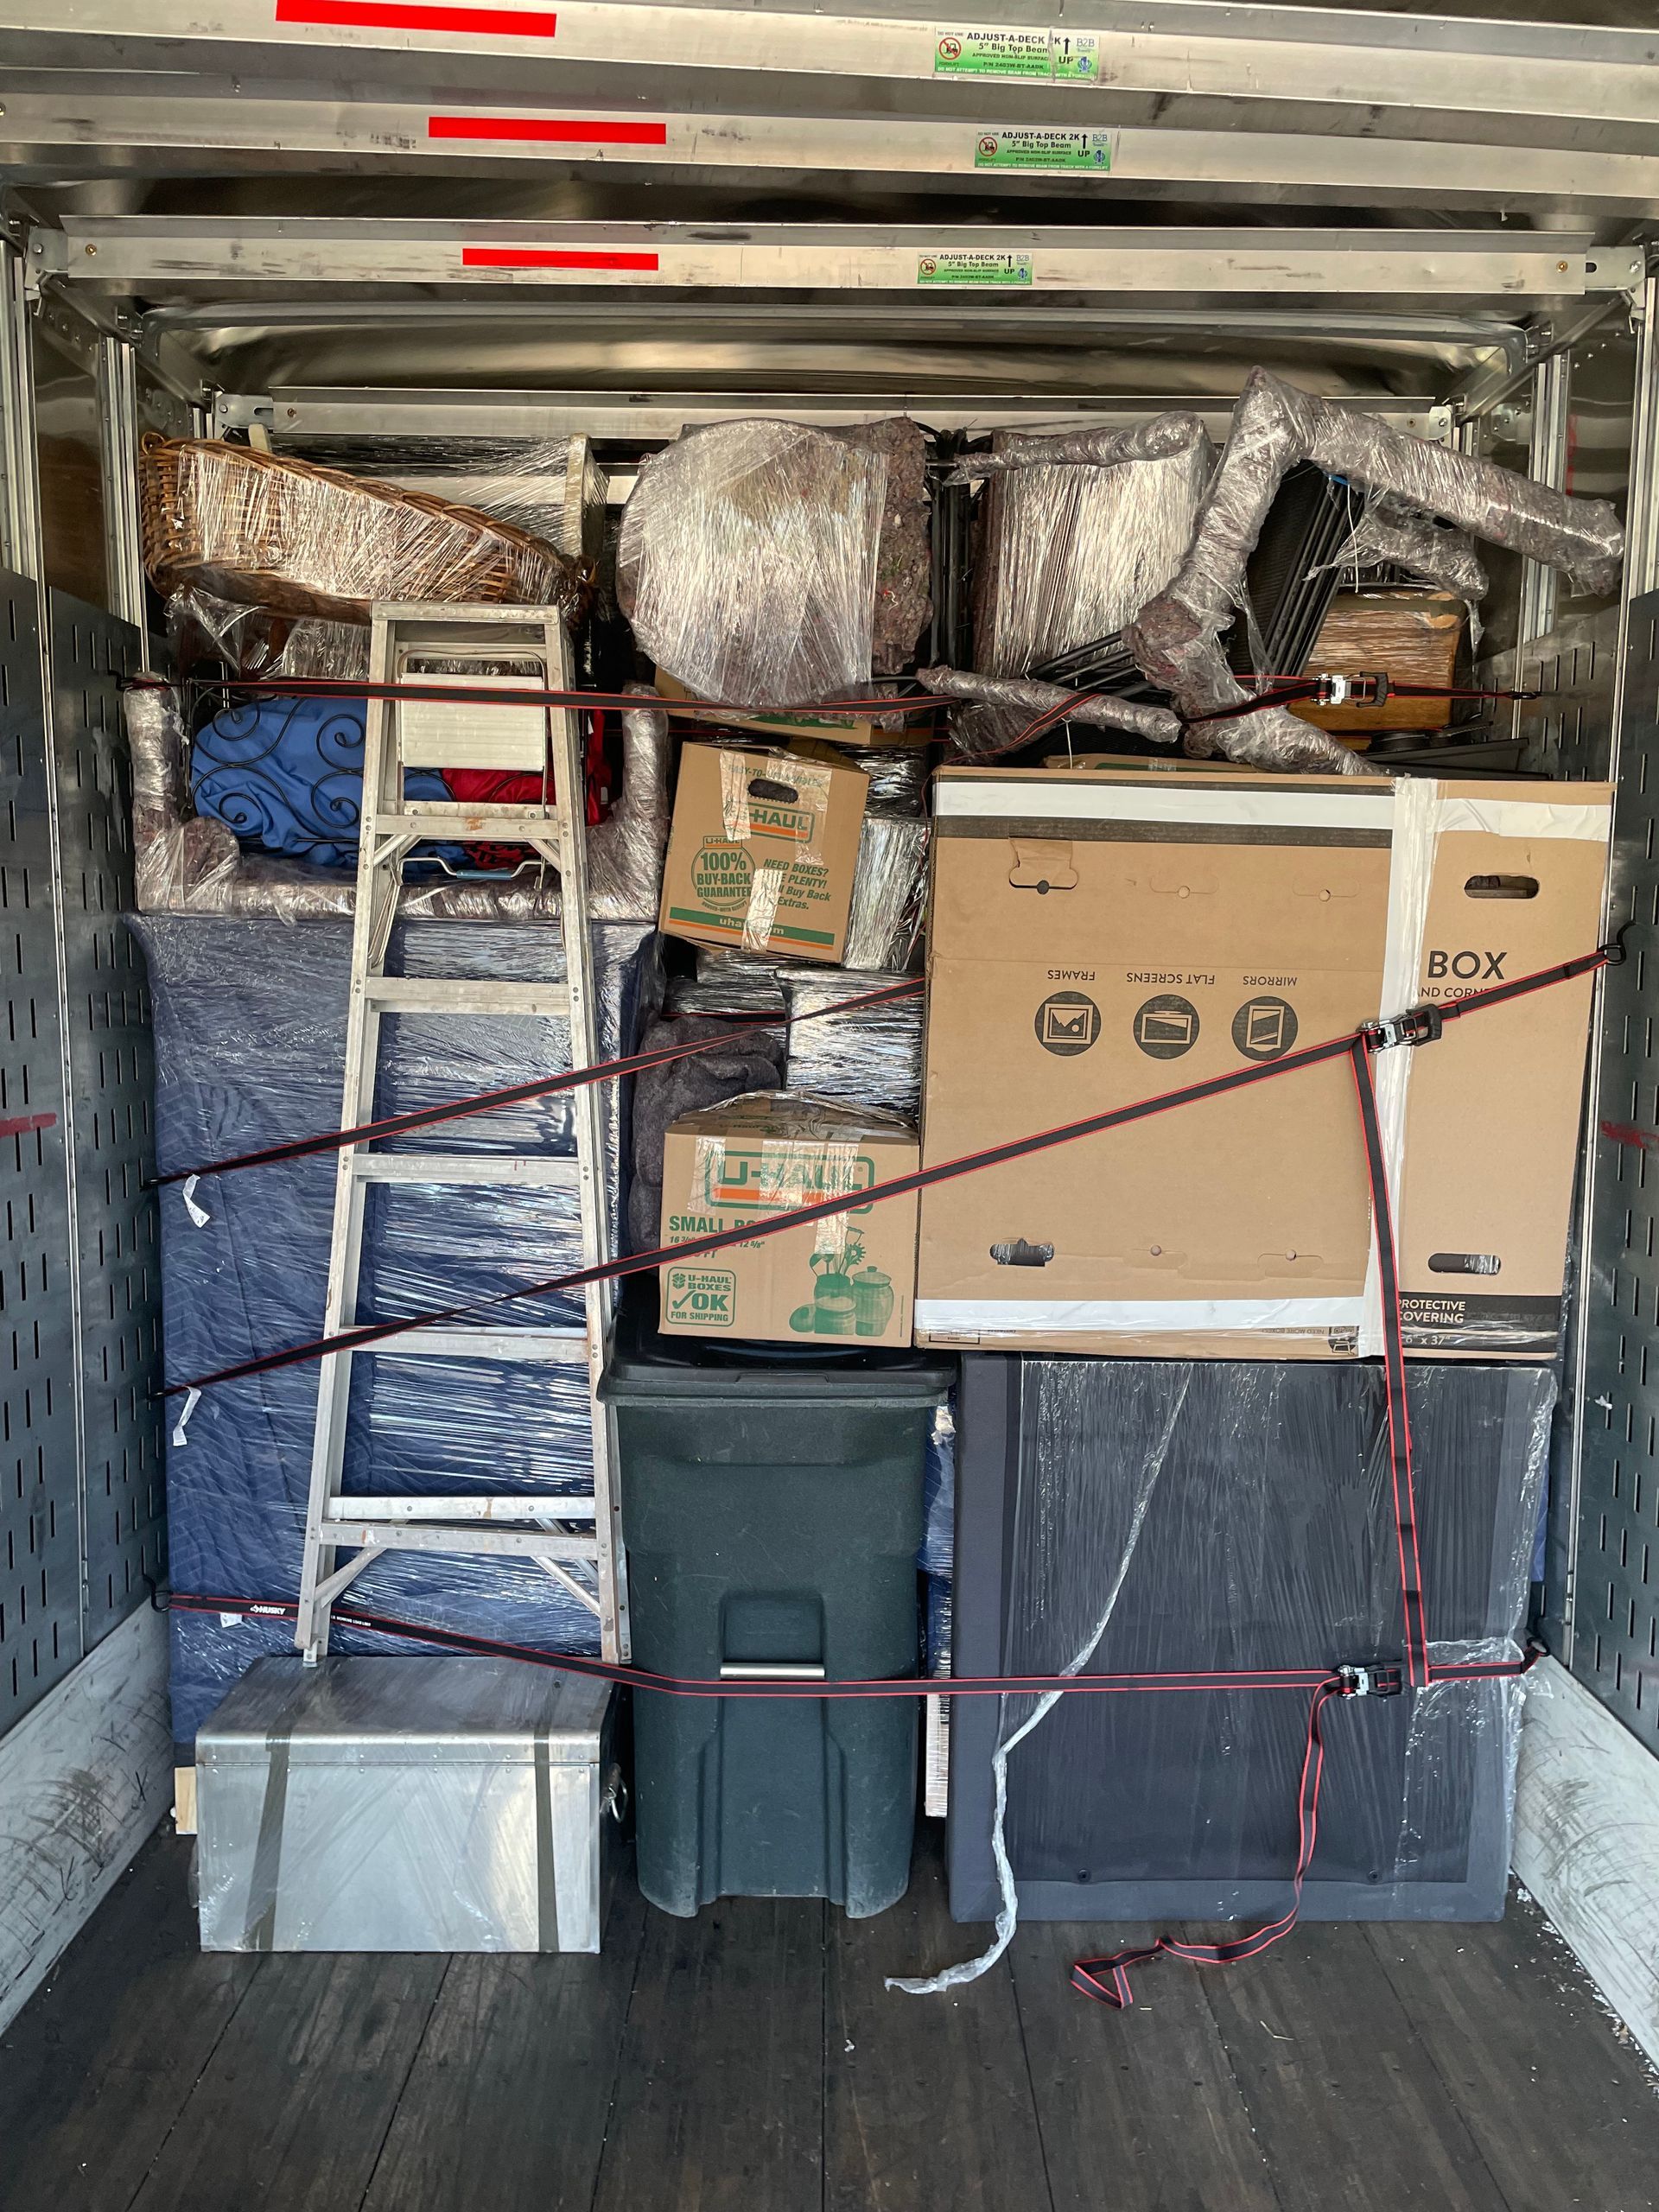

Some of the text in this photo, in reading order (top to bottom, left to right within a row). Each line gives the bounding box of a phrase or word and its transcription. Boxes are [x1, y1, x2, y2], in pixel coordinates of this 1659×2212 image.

[967, 32, 1045, 44] ADJUST-A-DECK
[1077, 38, 1095, 47] B2B
[991, 43, 1006, 53] Big
[1008, 44, 1023, 54] Top
[1001, 131, 1066, 140] ADJUST-A-DECK
[1036, 141, 1049, 149] Top
[736, 806, 809, 830] -HAUL
[700, 852, 747, 871] 100%
[763, 858, 790, 871] NEED
[791, 863, 830, 878] BOXES?
[696, 873, 751, 885] BUY-BACK
[788, 874, 828, 888] PLENTY!
[786, 887, 805, 898] Buy
[807, 889, 831, 901] Back
[778, 896, 810, 910] Extras.
[1427, 950, 1508, 980] BOX
[1047, 969, 1096, 981] FRAMES
[1127, 972, 1215, 985] FLAT SCREENS
[1243, 976, 1298, 987] MIRRORS
[1418, 987, 1440, 997] ND
[688, 1274, 731, 1284] U-HAUL
[688, 1282, 731, 1292] BOXES
[691, 1293, 728, 1312] OK
[690, 1313, 728, 1322] SHIPPING
[259, 1605, 286, 1615] HUSKY
